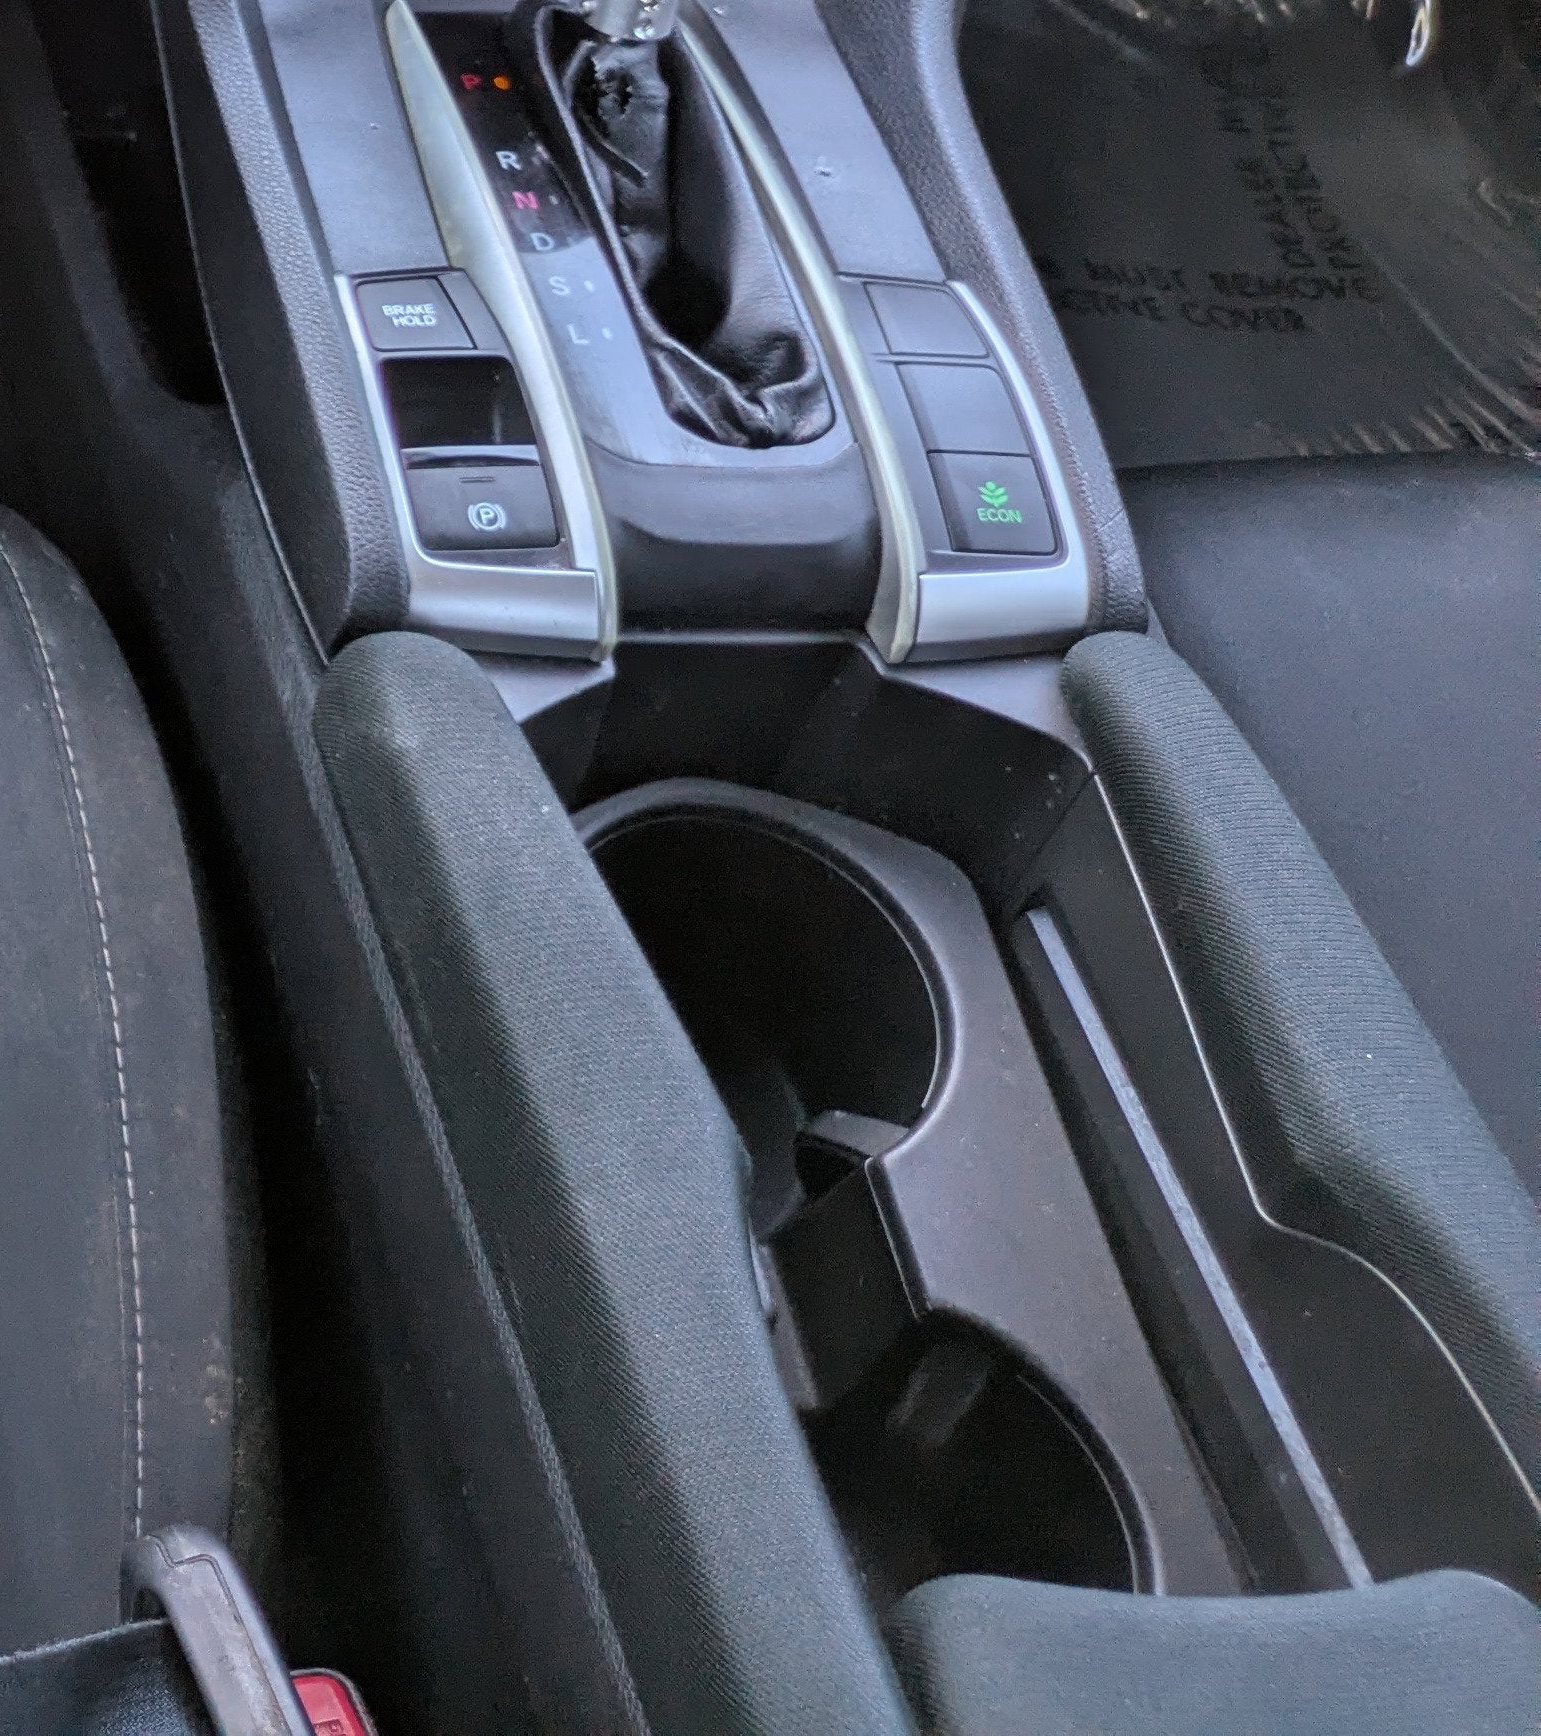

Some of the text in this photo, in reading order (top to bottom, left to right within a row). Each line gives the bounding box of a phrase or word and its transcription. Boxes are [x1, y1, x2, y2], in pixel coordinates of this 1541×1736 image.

[495, 150, 522, 171] R
[511, 190, 539, 210] N
[529, 232, 556, 251] D
[548, 275, 570, 296] S
[382, 303, 437, 317] BRAKE
[392, 315, 437, 328] HOLD
[566, 323, 590, 345] L
[977, 508, 1022, 524] ECON
